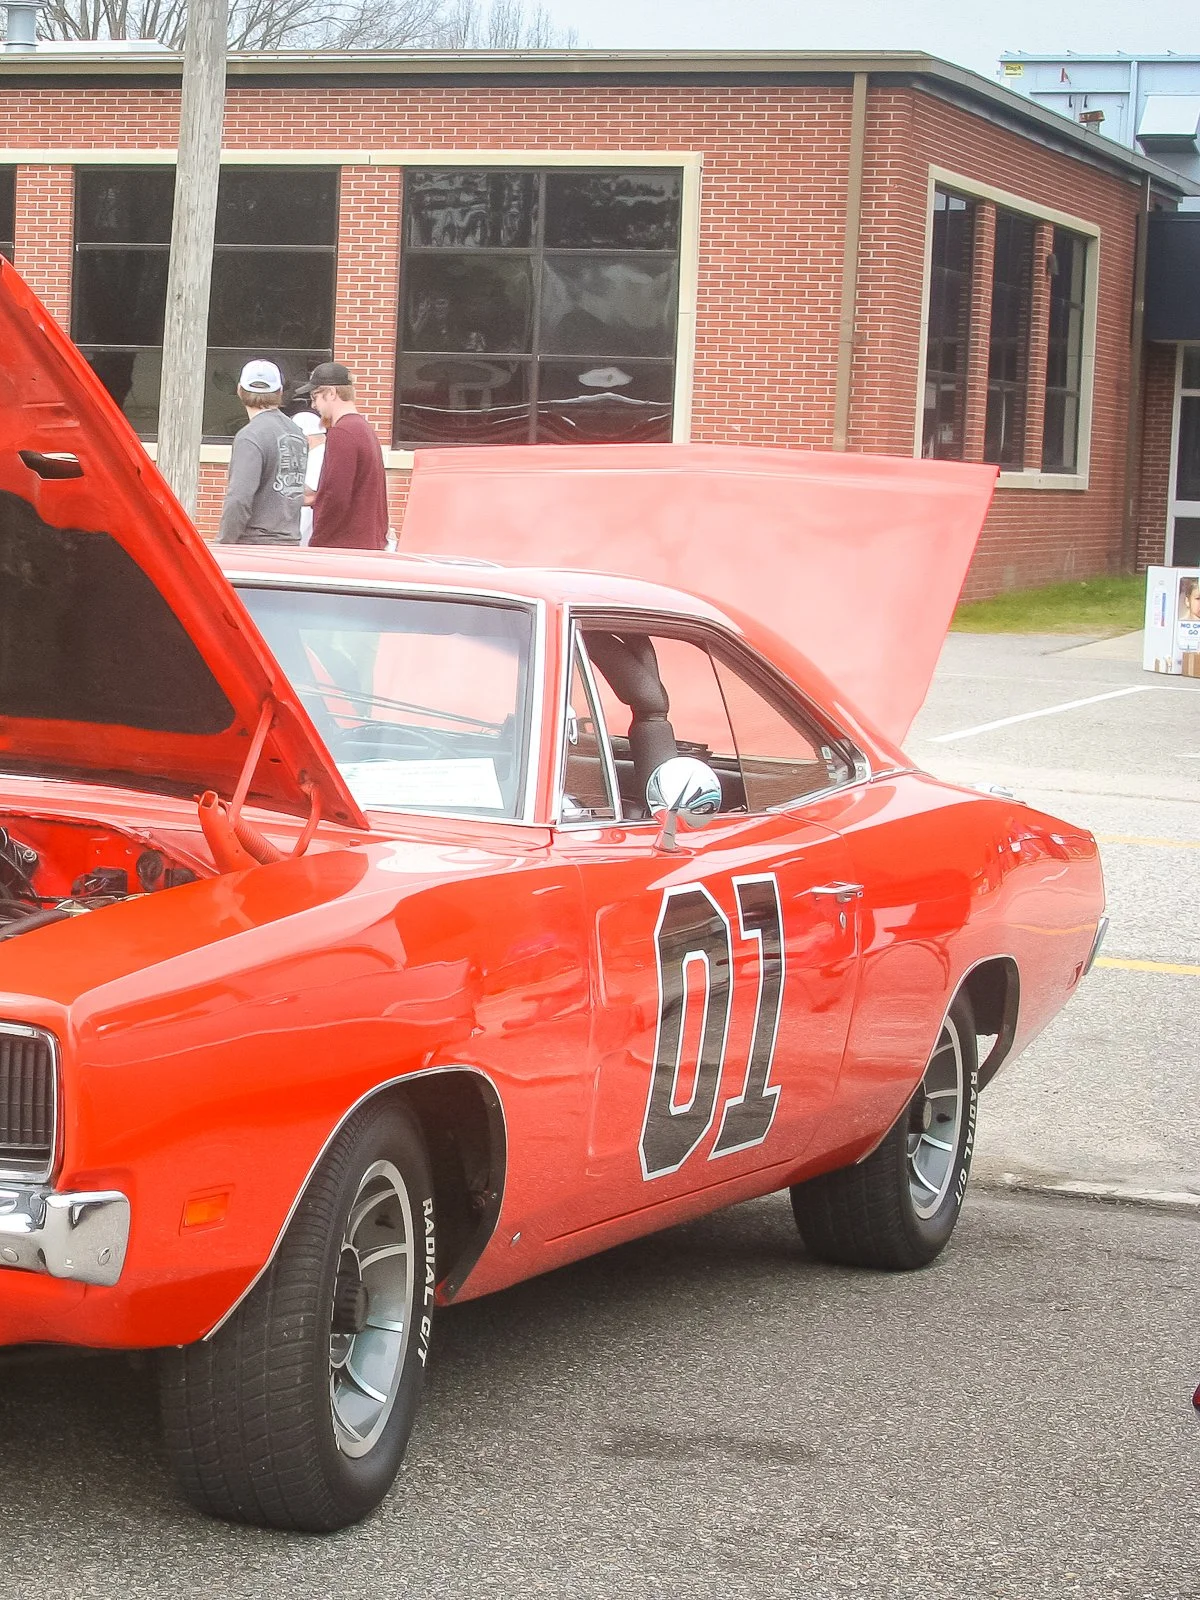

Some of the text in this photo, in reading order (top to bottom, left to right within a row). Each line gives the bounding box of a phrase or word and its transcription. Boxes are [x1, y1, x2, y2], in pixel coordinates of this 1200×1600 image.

[638, 872, 786, 1182] 01
[954, 1070, 978, 1206] RADIAL G/T
[417, 1197, 436, 1368] RADIAL G/T
